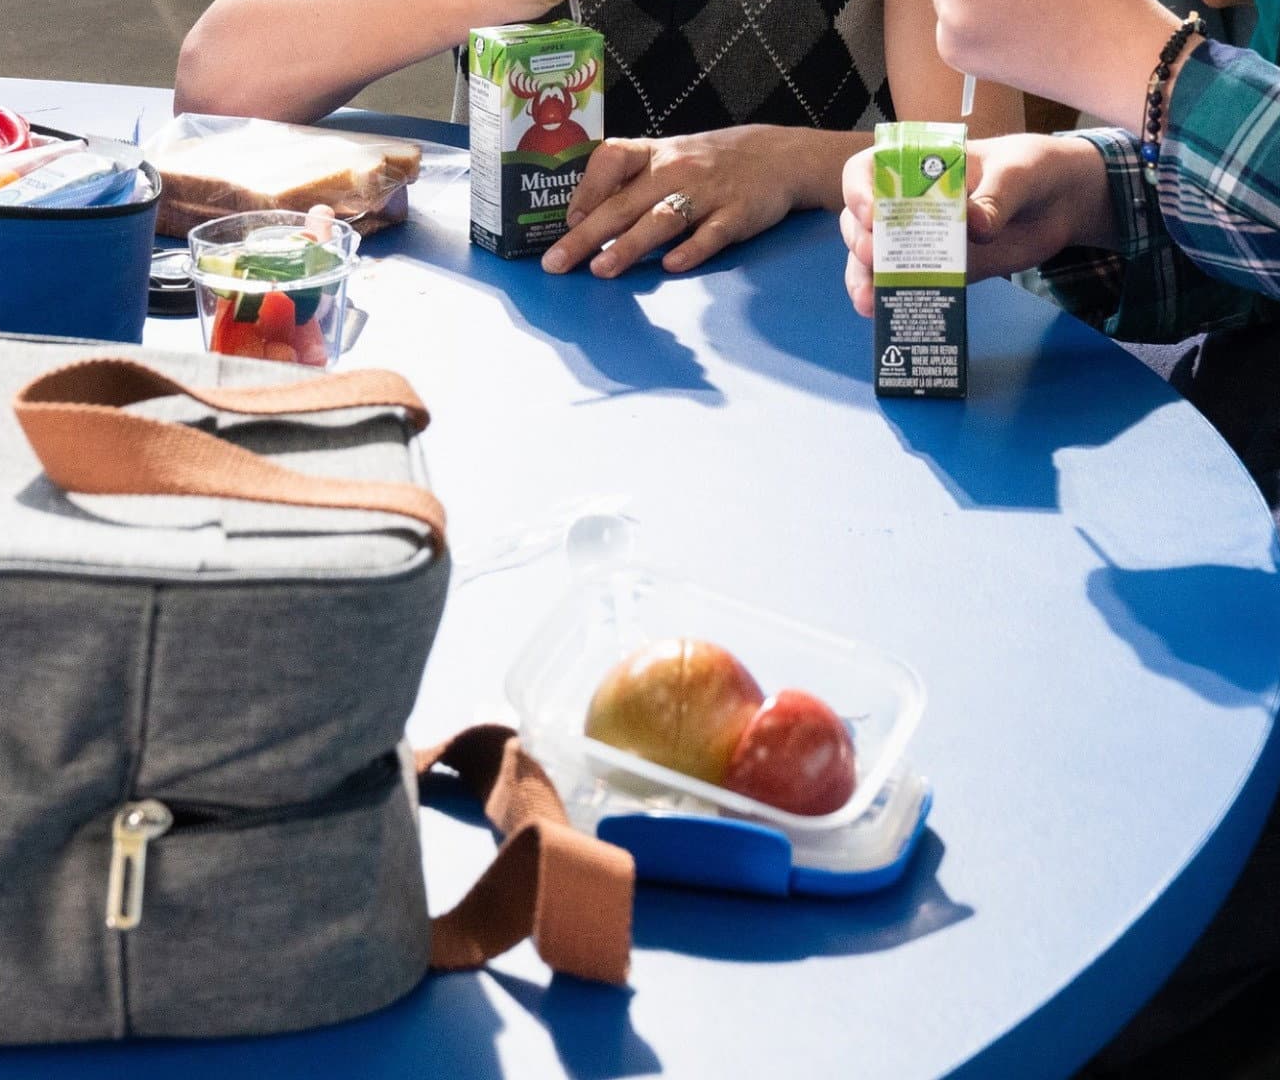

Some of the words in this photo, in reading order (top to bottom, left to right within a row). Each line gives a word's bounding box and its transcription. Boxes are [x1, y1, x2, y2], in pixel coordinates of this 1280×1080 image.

[911, 345, 929, 355] RETURN
[930, 345, 939, 355] FOR
[940, 345, 958, 355] REFUND
[930, 356, 957, 366] APPLICABLE
[911, 366, 942, 377] RETOURNER
[943, 366, 958, 377] POUR
